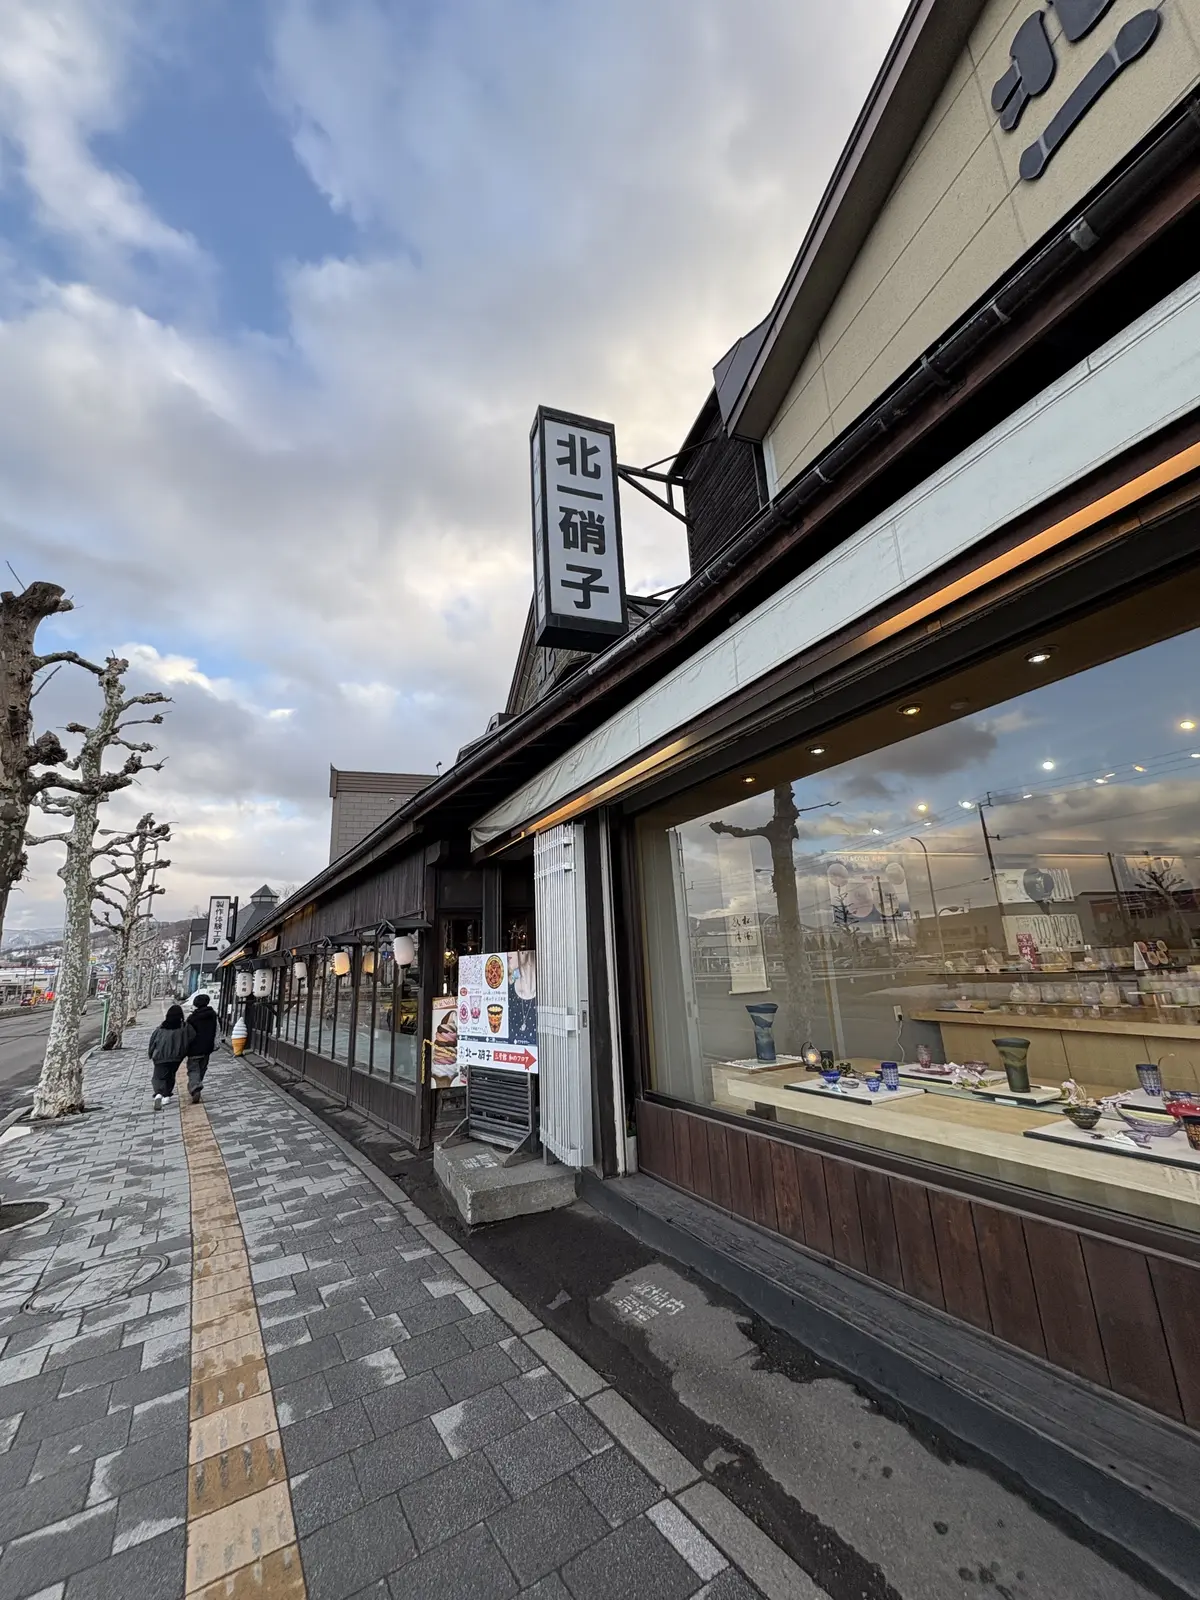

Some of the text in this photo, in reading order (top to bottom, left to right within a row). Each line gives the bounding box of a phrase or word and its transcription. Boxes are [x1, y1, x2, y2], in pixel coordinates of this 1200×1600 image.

[555, 433, 610, 610] 北一硝子
[465, 1047, 492, 1061] 北一硝子
